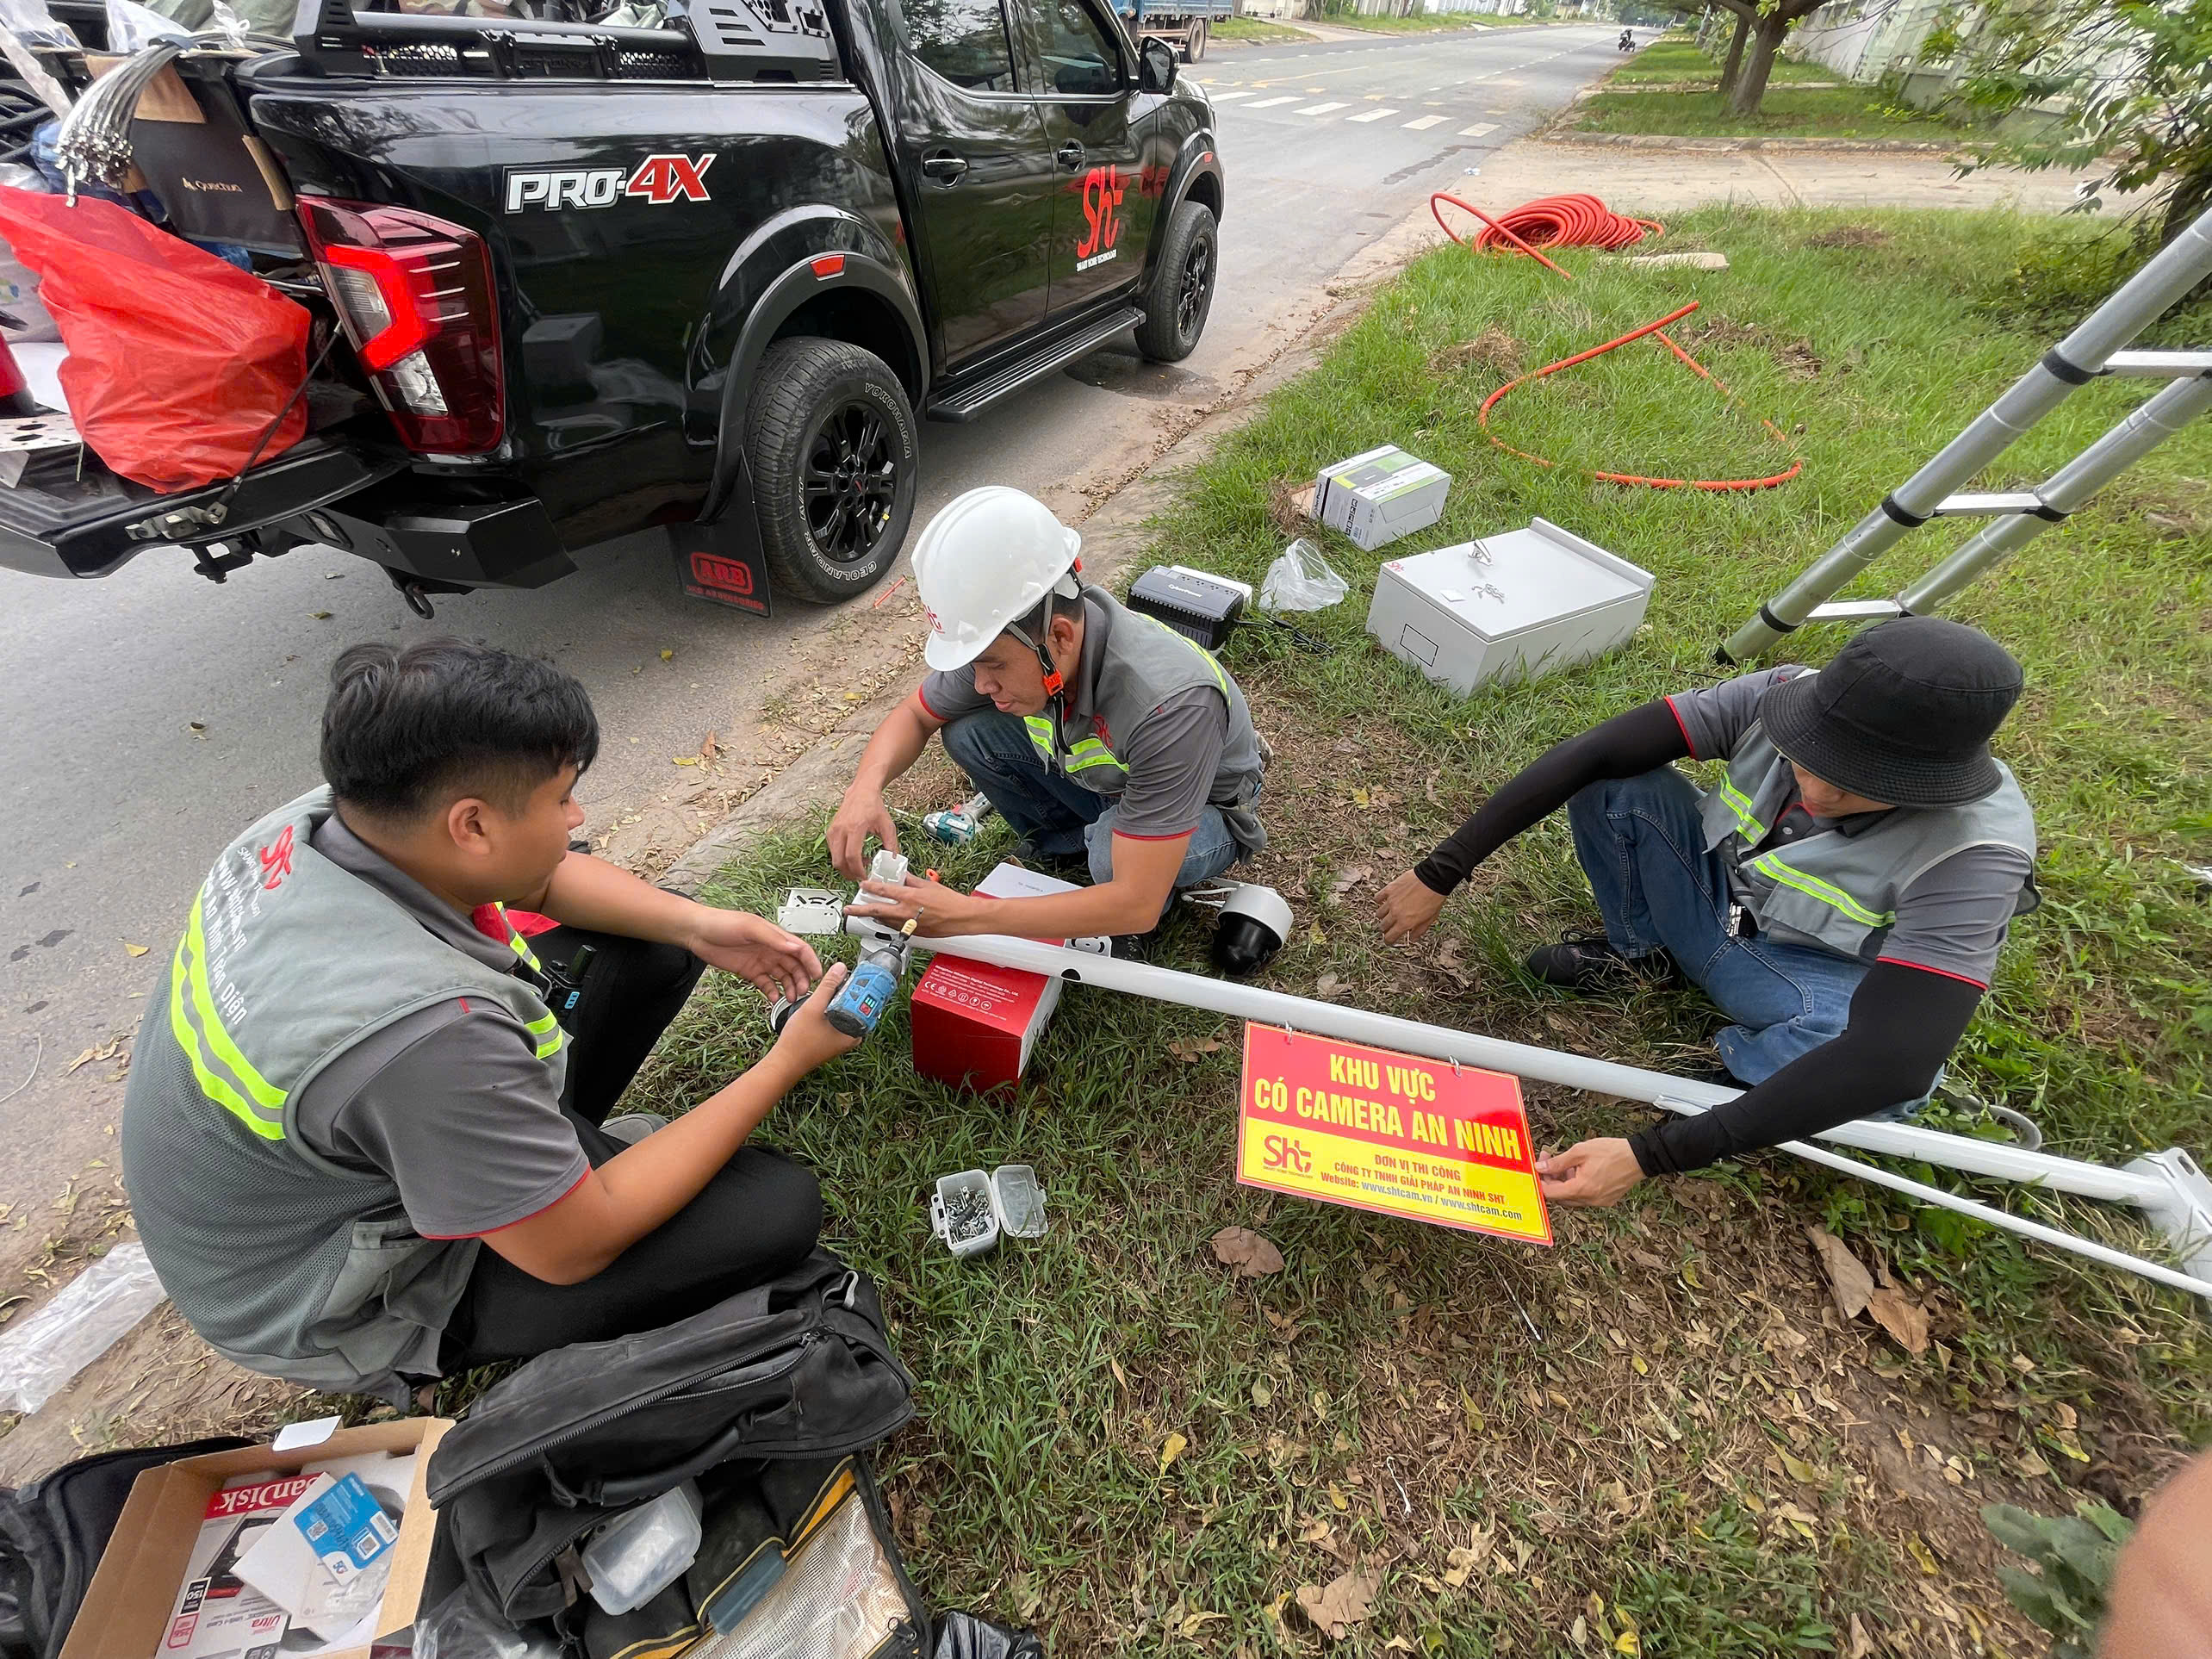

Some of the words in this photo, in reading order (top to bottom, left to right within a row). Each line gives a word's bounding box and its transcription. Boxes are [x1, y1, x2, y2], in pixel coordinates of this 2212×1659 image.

[506, 153, 718, 212] PRO-4X
[1078, 164, 1123, 258] Sht
[864, 382, 912, 459] YOKOHAMA
[805, 531, 878, 581] GEOLANDAR
[221, 982, 248, 1026] Diện
[1330, 1053, 1380, 1090] KHU
[1385, 1065, 1436, 1104] VỰC
[1254, 1077, 1288, 1113] CÓ
[1296, 1086, 1404, 1138] CAMERA
[1412, 1110, 1448, 1146] AN
[1454, 1118, 1522, 1160] NINH
[1264, 1135, 1311, 1172] Sht
[1375, 1154, 1396, 1169] ĐƠN
[1399, 1159, 1410, 1173] VỊ
[1412, 1161, 1429, 1175] THI
[1432, 1165, 1462, 1181] CÔNG
[1320, 1171, 1359, 1189] Website:
[1361, 1181, 1433, 1203] www.shtcam.vn
[1440, 1197, 1522, 1221] www.shtcam.com
[1334, 1161, 1359, 1176] CÔNG
[1361, 1167, 1372, 1178] TY
[1373, 1170, 1398, 1184] TNHH
[1400, 1174, 1419, 1188] GIẢI
[1420, 1179, 1445, 1193] PHÁP
[1448, 1184, 1461, 1196] AN
[1463, 1188, 1486, 1201] NINH
[1488, 1192, 1506, 1205] SHT
[186, 1589, 204, 1600] 150
[251, 1615, 281, 1628] Ultra
